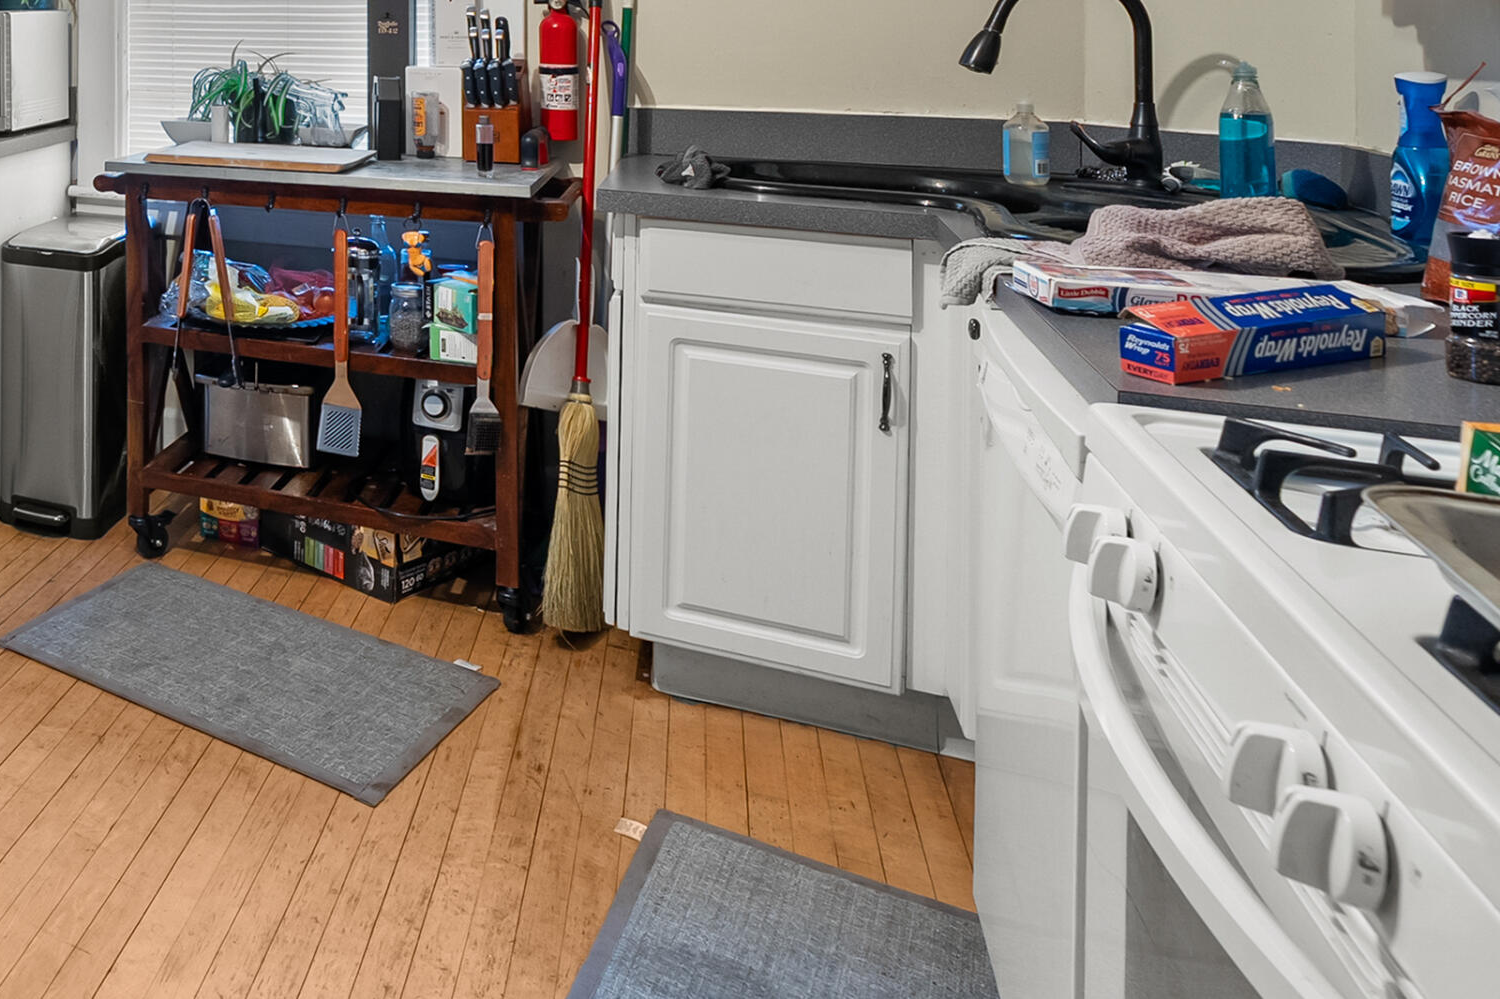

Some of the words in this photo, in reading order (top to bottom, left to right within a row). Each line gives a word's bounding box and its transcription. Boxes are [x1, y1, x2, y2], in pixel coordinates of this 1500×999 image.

[1448, 191, 1486, 209] RICE
[1060, 290, 1081, 298] Little
[1081, 289, 1107, 297] Debbie
[1221, 300, 1283, 320] Wrap
[1270, 291, 1351, 315] Reynolds
[1124, 341, 1151, 356] Wrap
[1126, 334, 1170, 351] Reynolds
[1178, 342, 1190, 354] 75
[1254, 335, 1299, 363] Wrap
[1297, 324, 1368, 358] Reynolds
[1154, 350, 1171, 364] 75
[400, 576, 416, 590] 120
